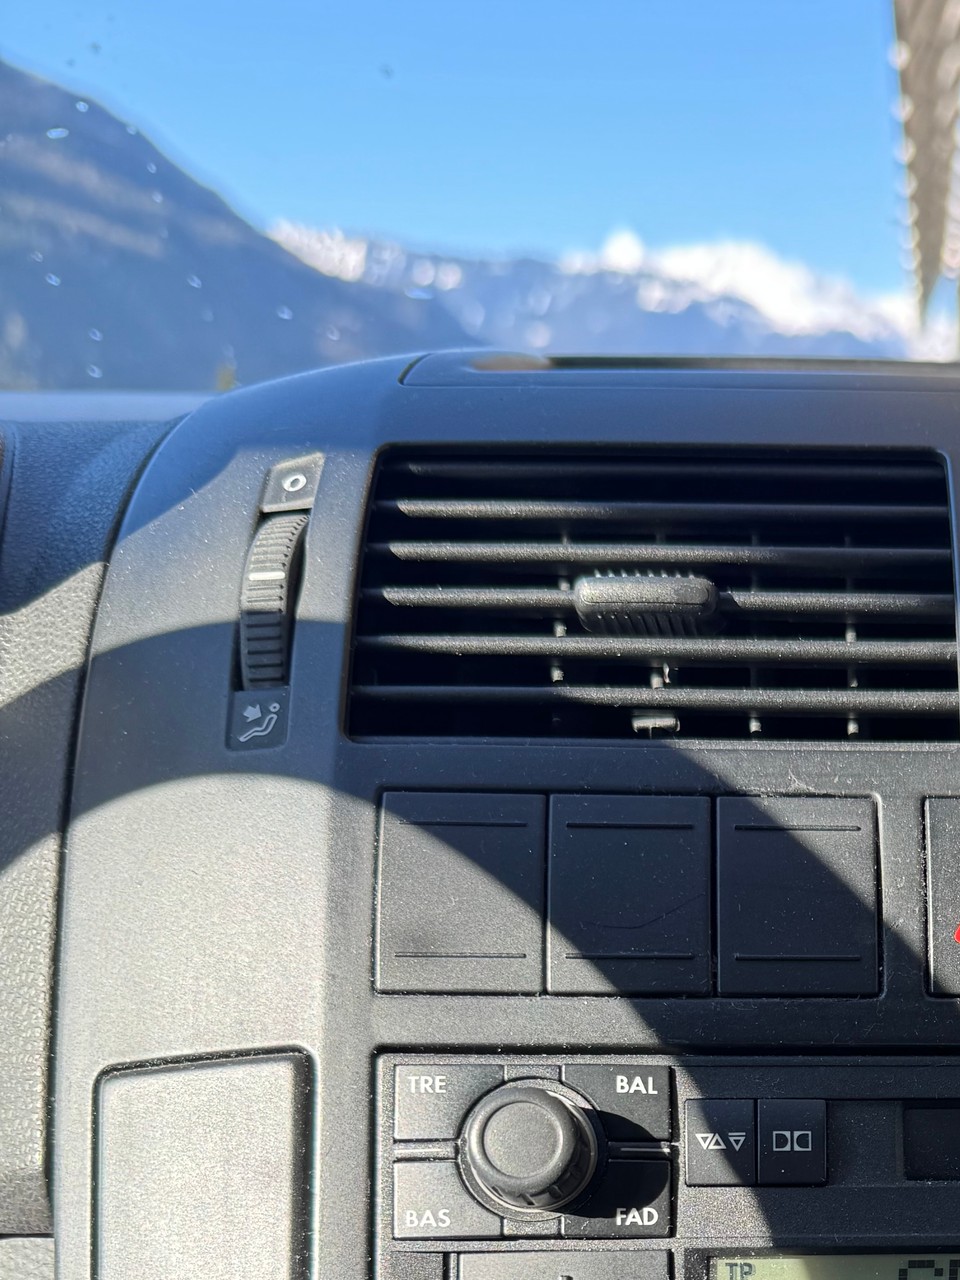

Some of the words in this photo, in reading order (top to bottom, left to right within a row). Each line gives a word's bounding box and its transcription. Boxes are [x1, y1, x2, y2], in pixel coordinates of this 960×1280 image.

[408, 1076, 446, 1094] TRE
[616, 1076, 659, 1095] BAL
[405, 1210, 450, 1228] BAS
[616, 1208, 659, 1226] FAD
